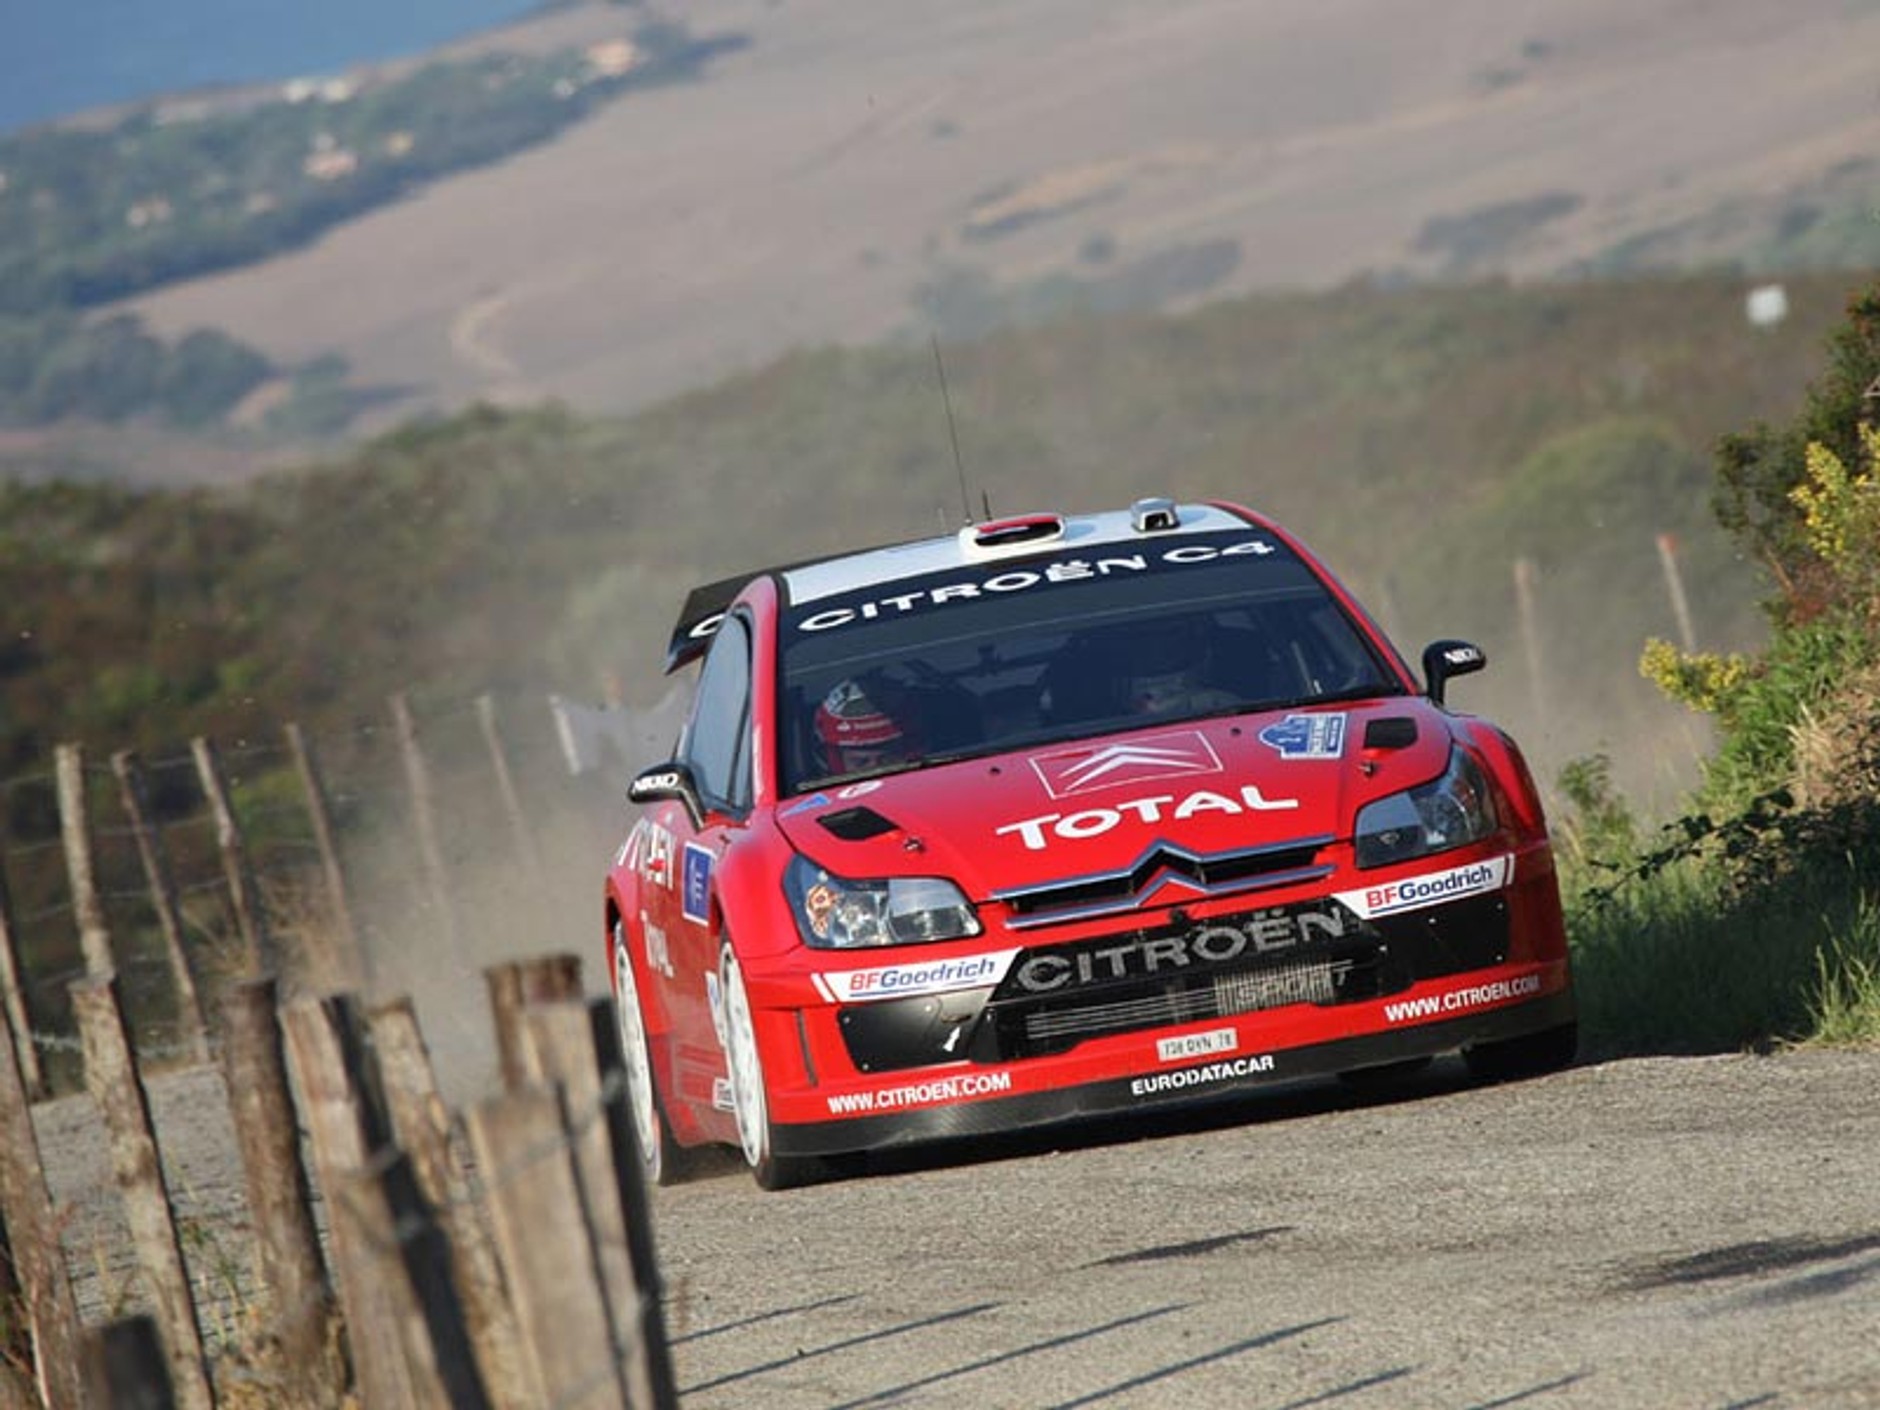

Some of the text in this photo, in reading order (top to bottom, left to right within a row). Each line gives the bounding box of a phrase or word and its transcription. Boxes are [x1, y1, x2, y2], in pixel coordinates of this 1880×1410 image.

[799, 541, 1275, 631] CITROËN C4
[996, 786, 1298, 849] TOTAL
[1366, 865, 1493, 908] BFGoodrich
[1017, 907, 1346, 992] CITROËN
[850, 958, 997, 991] BFGoodrich
[1384, 975, 1540, 1022] WWW.CITROEN.COM
[827, 1072, 1011, 1114] WWW.CITROEN.COM
[1131, 1055, 1275, 1095] EURODATACAR
